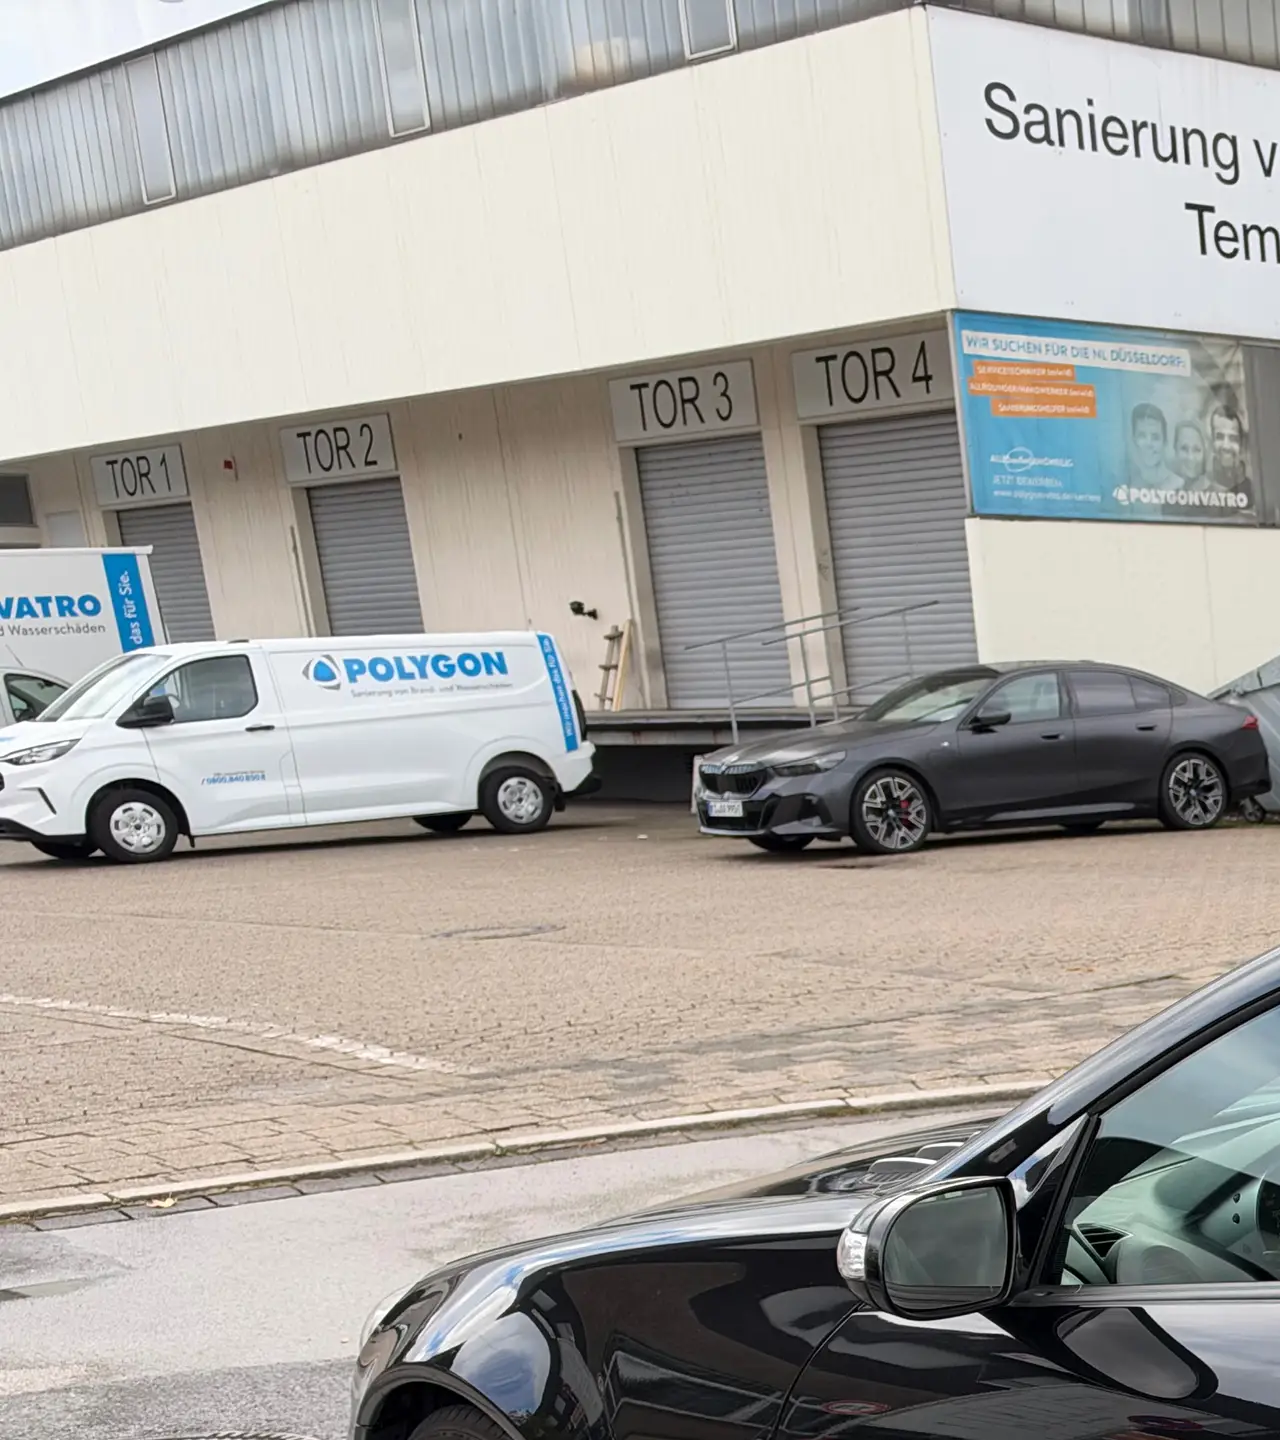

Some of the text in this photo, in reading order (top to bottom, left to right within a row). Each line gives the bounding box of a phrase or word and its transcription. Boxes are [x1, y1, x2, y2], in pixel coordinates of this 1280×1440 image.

[982, 80, 1241, 186] Sanierung
[965, 336, 989, 349] WIR
[992, 338, 1043, 355] SUCHEN
[1045, 341, 1068, 358] FÜR
[1071, 346, 1090, 360] DIE
[815, 340, 933, 407] TOR 4
[629, 371, 733, 432] TOR 3
[296, 423, 379, 475] TOR 2
[105, 452, 172, 499] TOR 1
[1130, 487, 1249, 508] POLYGONVATRO
[8, 623, 106, 636] Wasserschäden
[119, 570, 143, 644] das für Sie.
[342, 651, 509, 684] POLYGON
